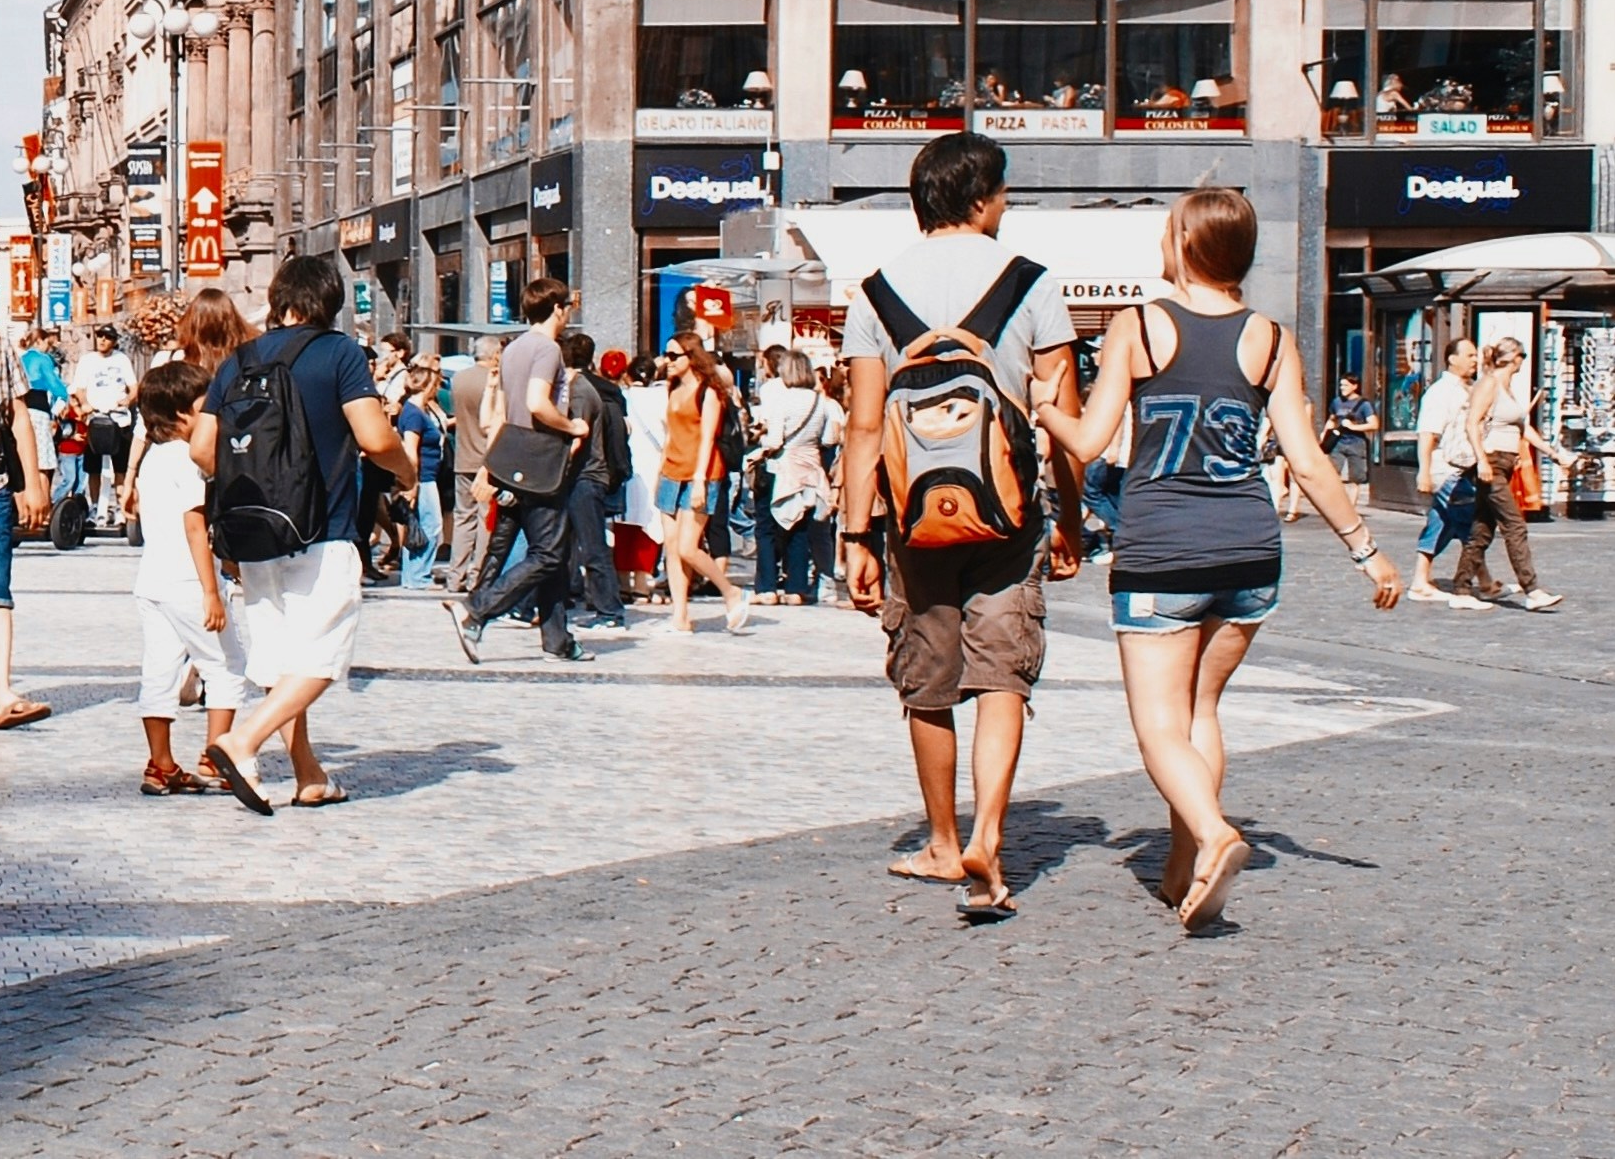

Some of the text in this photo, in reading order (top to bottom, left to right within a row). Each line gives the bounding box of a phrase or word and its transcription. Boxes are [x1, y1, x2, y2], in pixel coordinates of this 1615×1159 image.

[864, 109, 897, 119] PIZZA
[1144, 110, 1179, 119] PIZZA
[639, 116, 768, 131] GELATO ITALIANO
[986, 116, 1089, 131] PIZZA PASTA
[1144, 120, 1209, 130] COLOSEUM
[1429, 120, 1478, 134] SALAD
[1062, 284, 1144, 298] LOBASA
